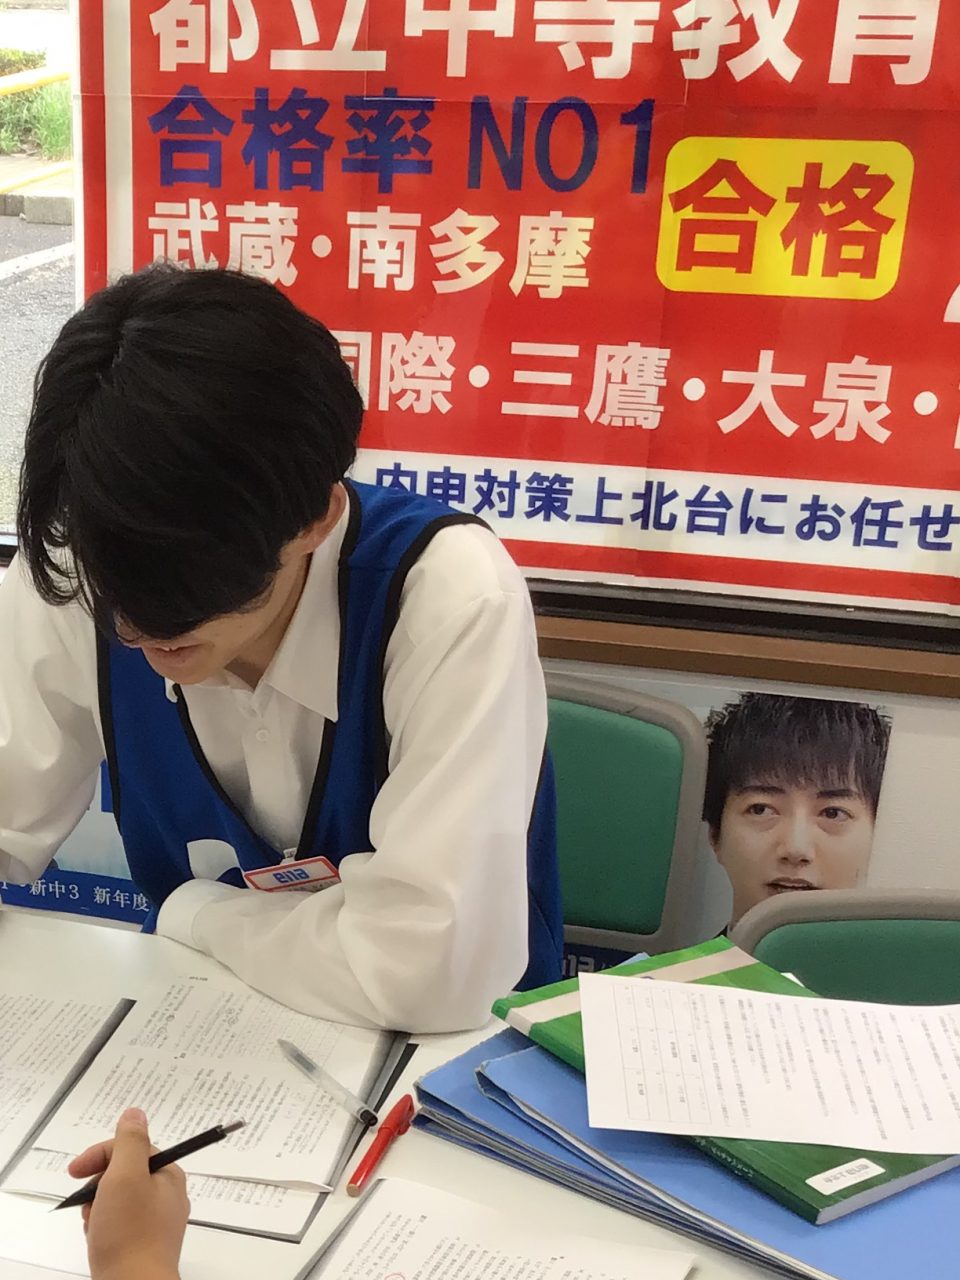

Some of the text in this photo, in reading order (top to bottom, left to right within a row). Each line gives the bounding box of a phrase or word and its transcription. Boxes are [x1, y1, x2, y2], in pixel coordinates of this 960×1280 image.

[150, 0, 938, 85] 都立中等教育
[148, 84, 656, 195] 合格率 NO1
[147, 198, 596, 299] 武蔵・南多摩
[669, 158, 899, 281] 合格
[93, 885, 150, 912] 新年度
[272, 867, 310, 884] ena
